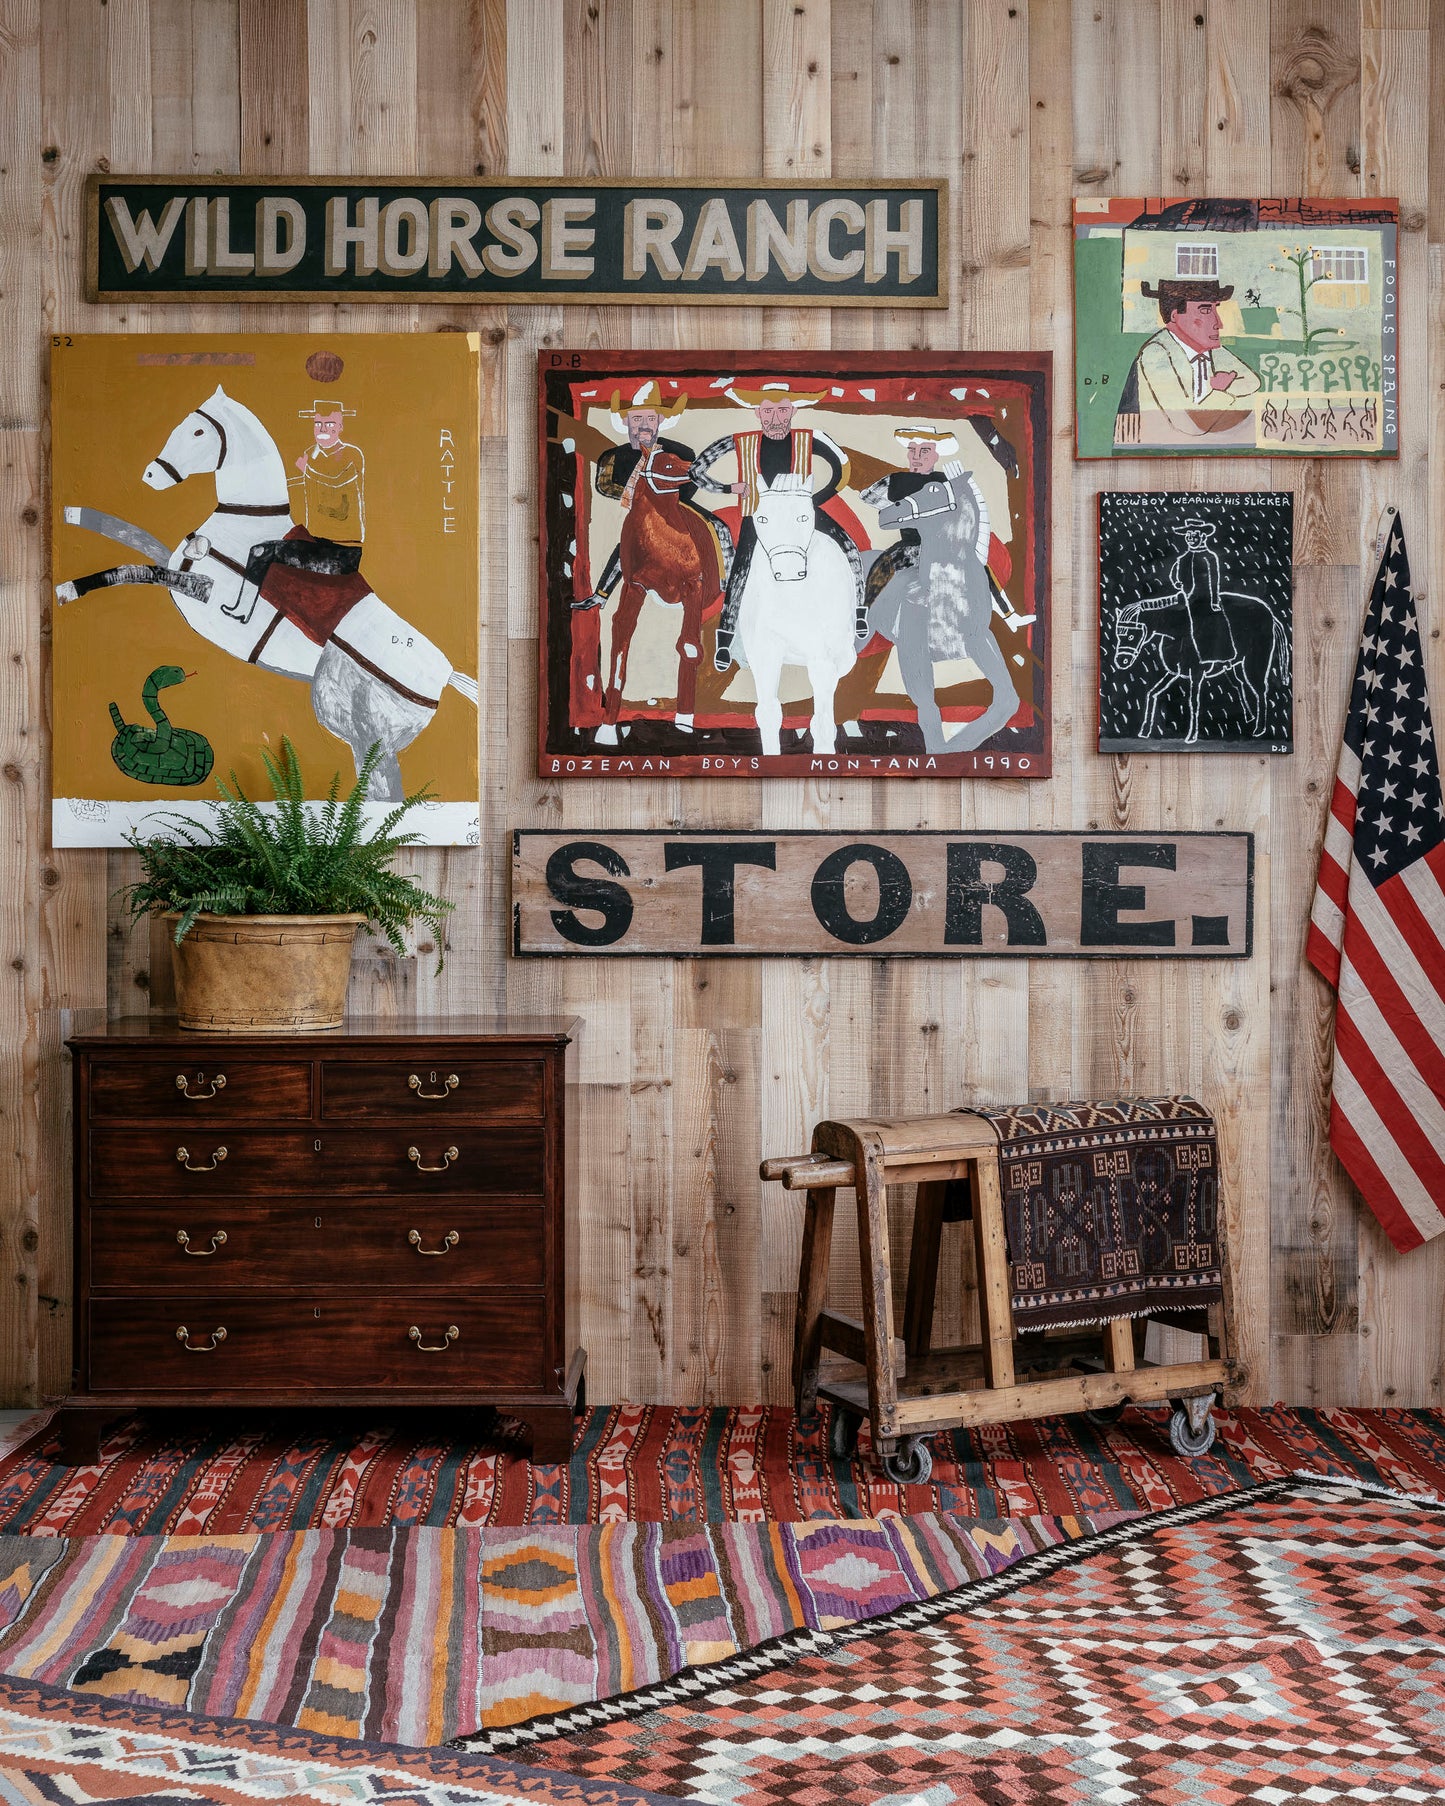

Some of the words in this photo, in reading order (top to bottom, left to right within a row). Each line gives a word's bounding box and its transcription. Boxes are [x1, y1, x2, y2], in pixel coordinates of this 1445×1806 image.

[104, 196, 307, 277] WILD
[324, 196, 596, 280] HORSE
[623, 198, 924, 284] RANCH
[1383, 260, 1396, 334] FOOLS
[1383, 354, 1397, 435] SPRING
[440, 429, 456, 533] RATTLE
[1102, 498, 1111, 507] A
[1116, 497, 1166, 506] COWBOY
[1172, 496, 1222, 505] WEARING
[1225, 497, 1241, 506] HIS
[1244, 496, 1291, 507] SLICKER
[551, 759, 670, 773] BOZEMAN
[702, 757, 760, 769] BOYS
[810, 756, 937, 771] MONTANA
[973, 756, 1031, 770] 1990
[545, 841, 1230, 947] STORE.
